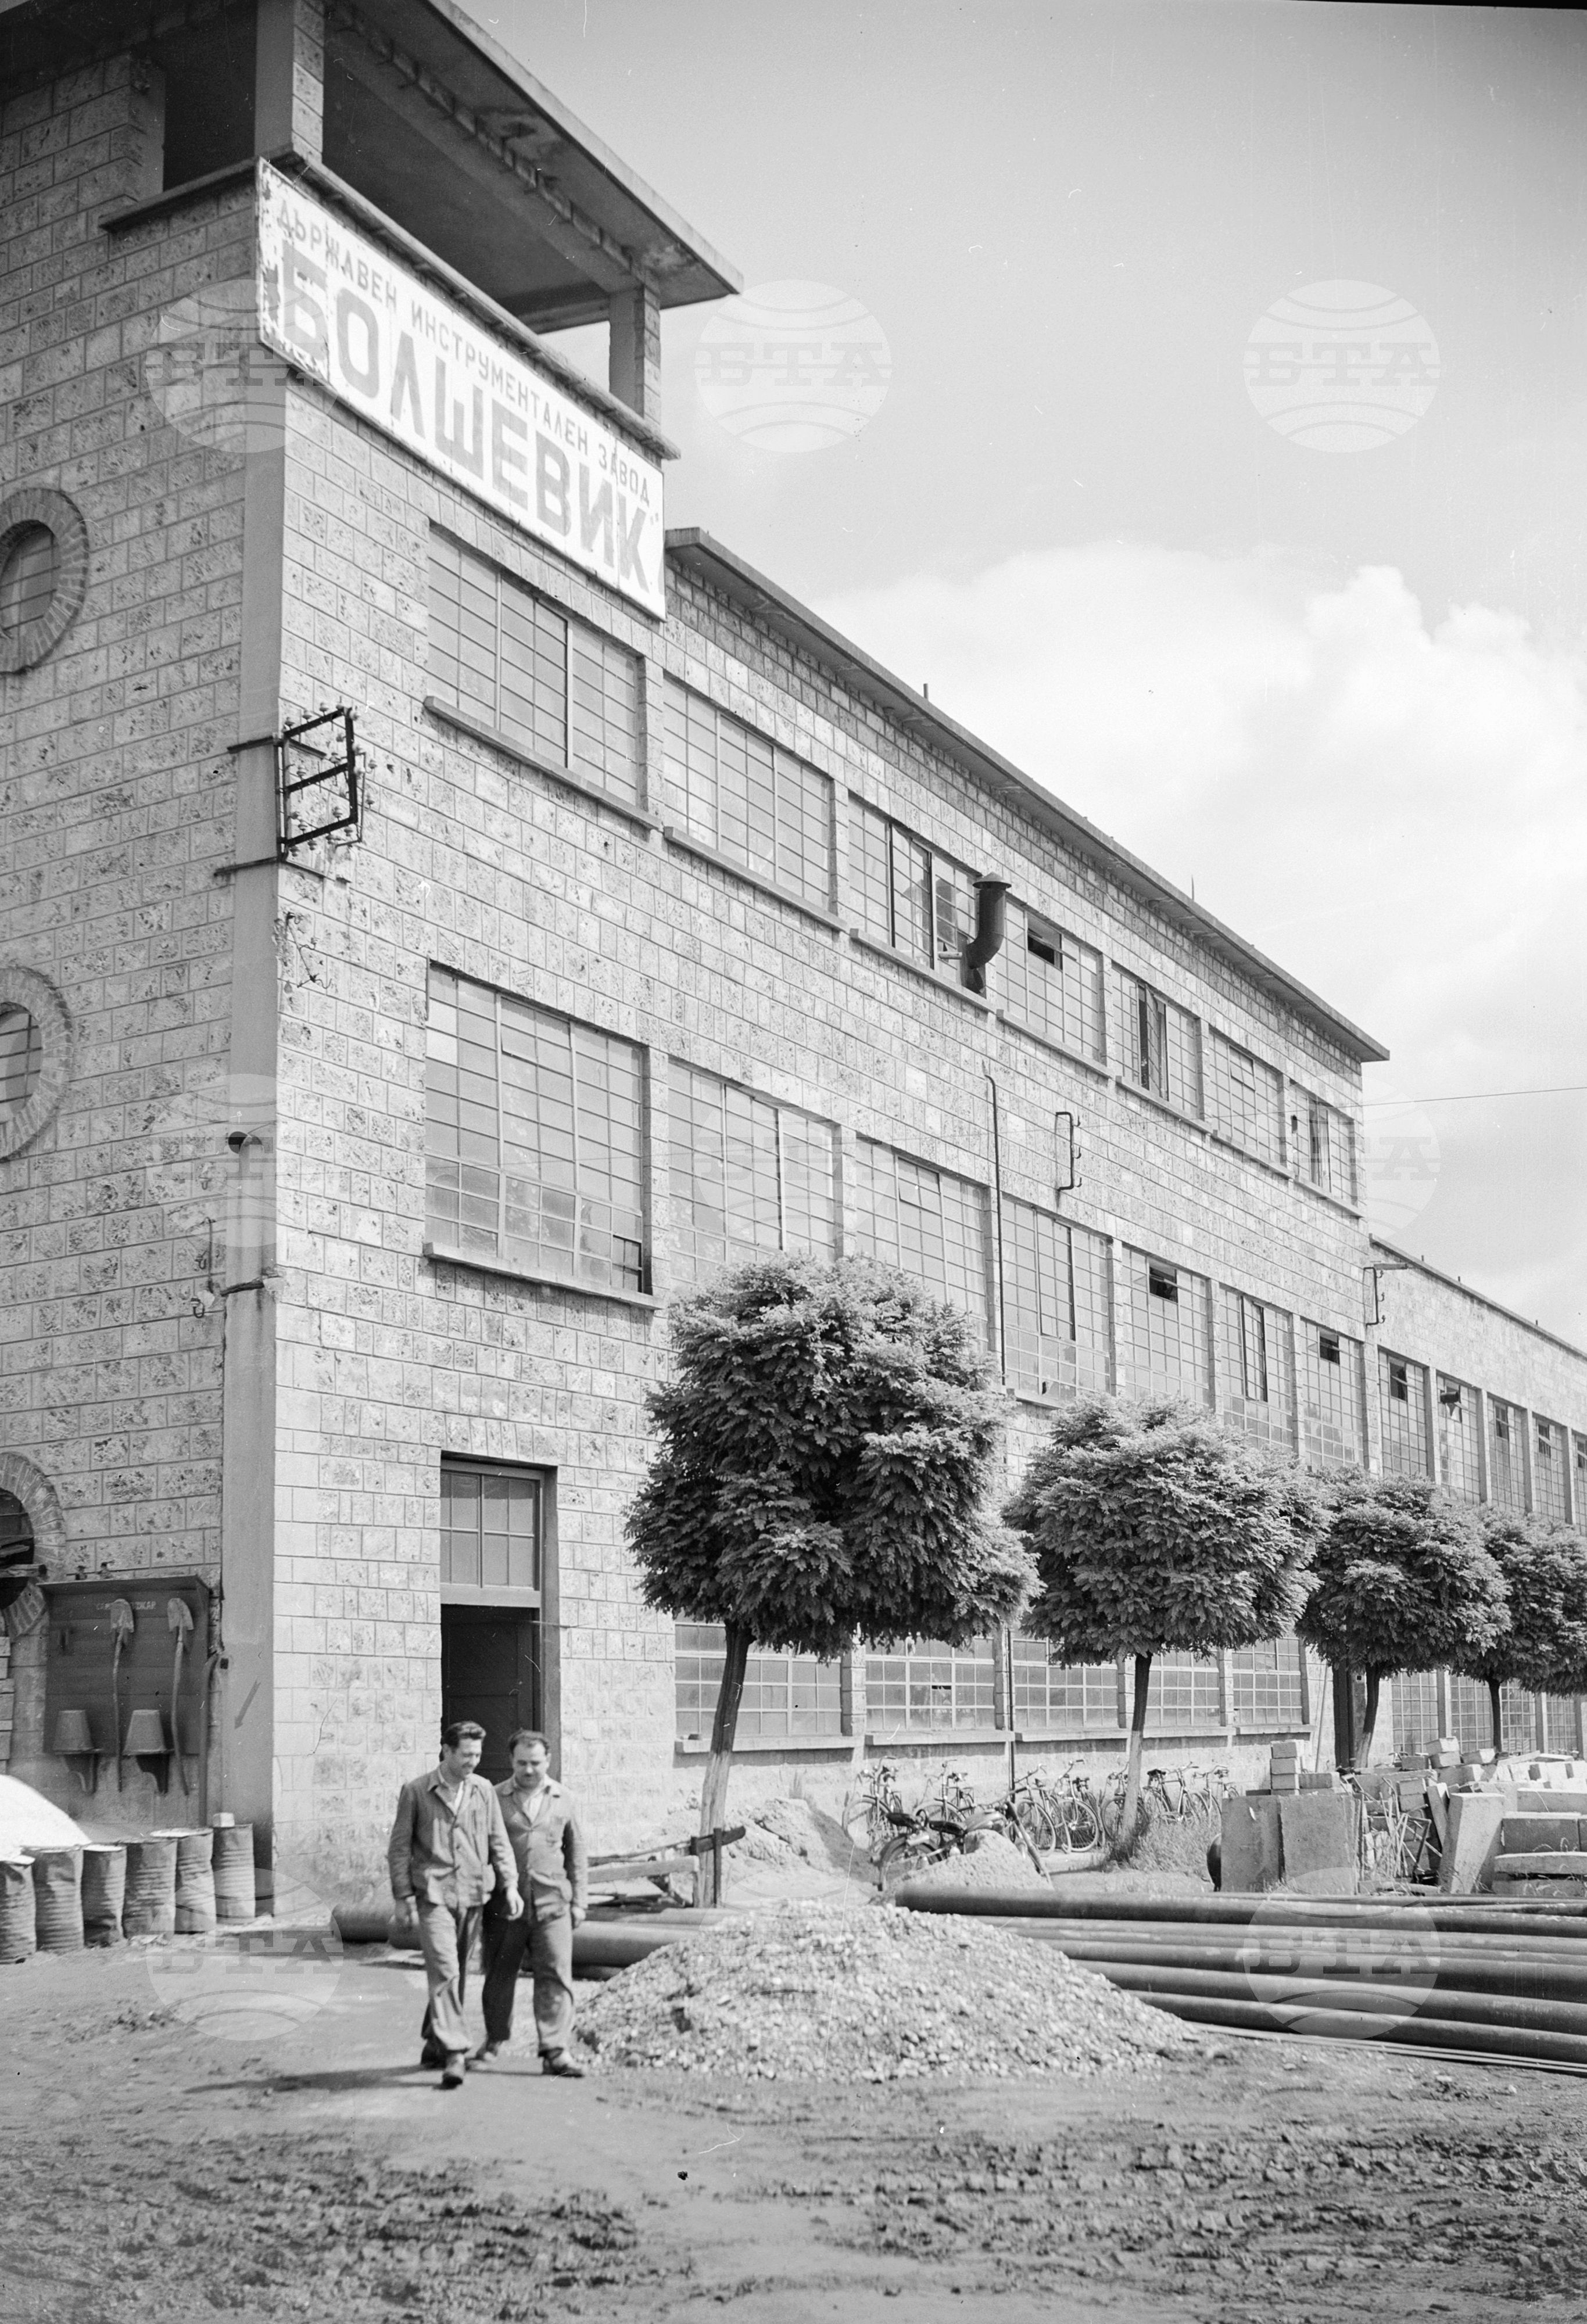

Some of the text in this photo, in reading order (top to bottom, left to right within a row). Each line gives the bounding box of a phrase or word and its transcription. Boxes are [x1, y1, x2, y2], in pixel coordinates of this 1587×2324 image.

[277, 199, 650, 507] ДЪРЖАВЕН ИНСТРУМЕНТАЛЕН ЗАВОД
